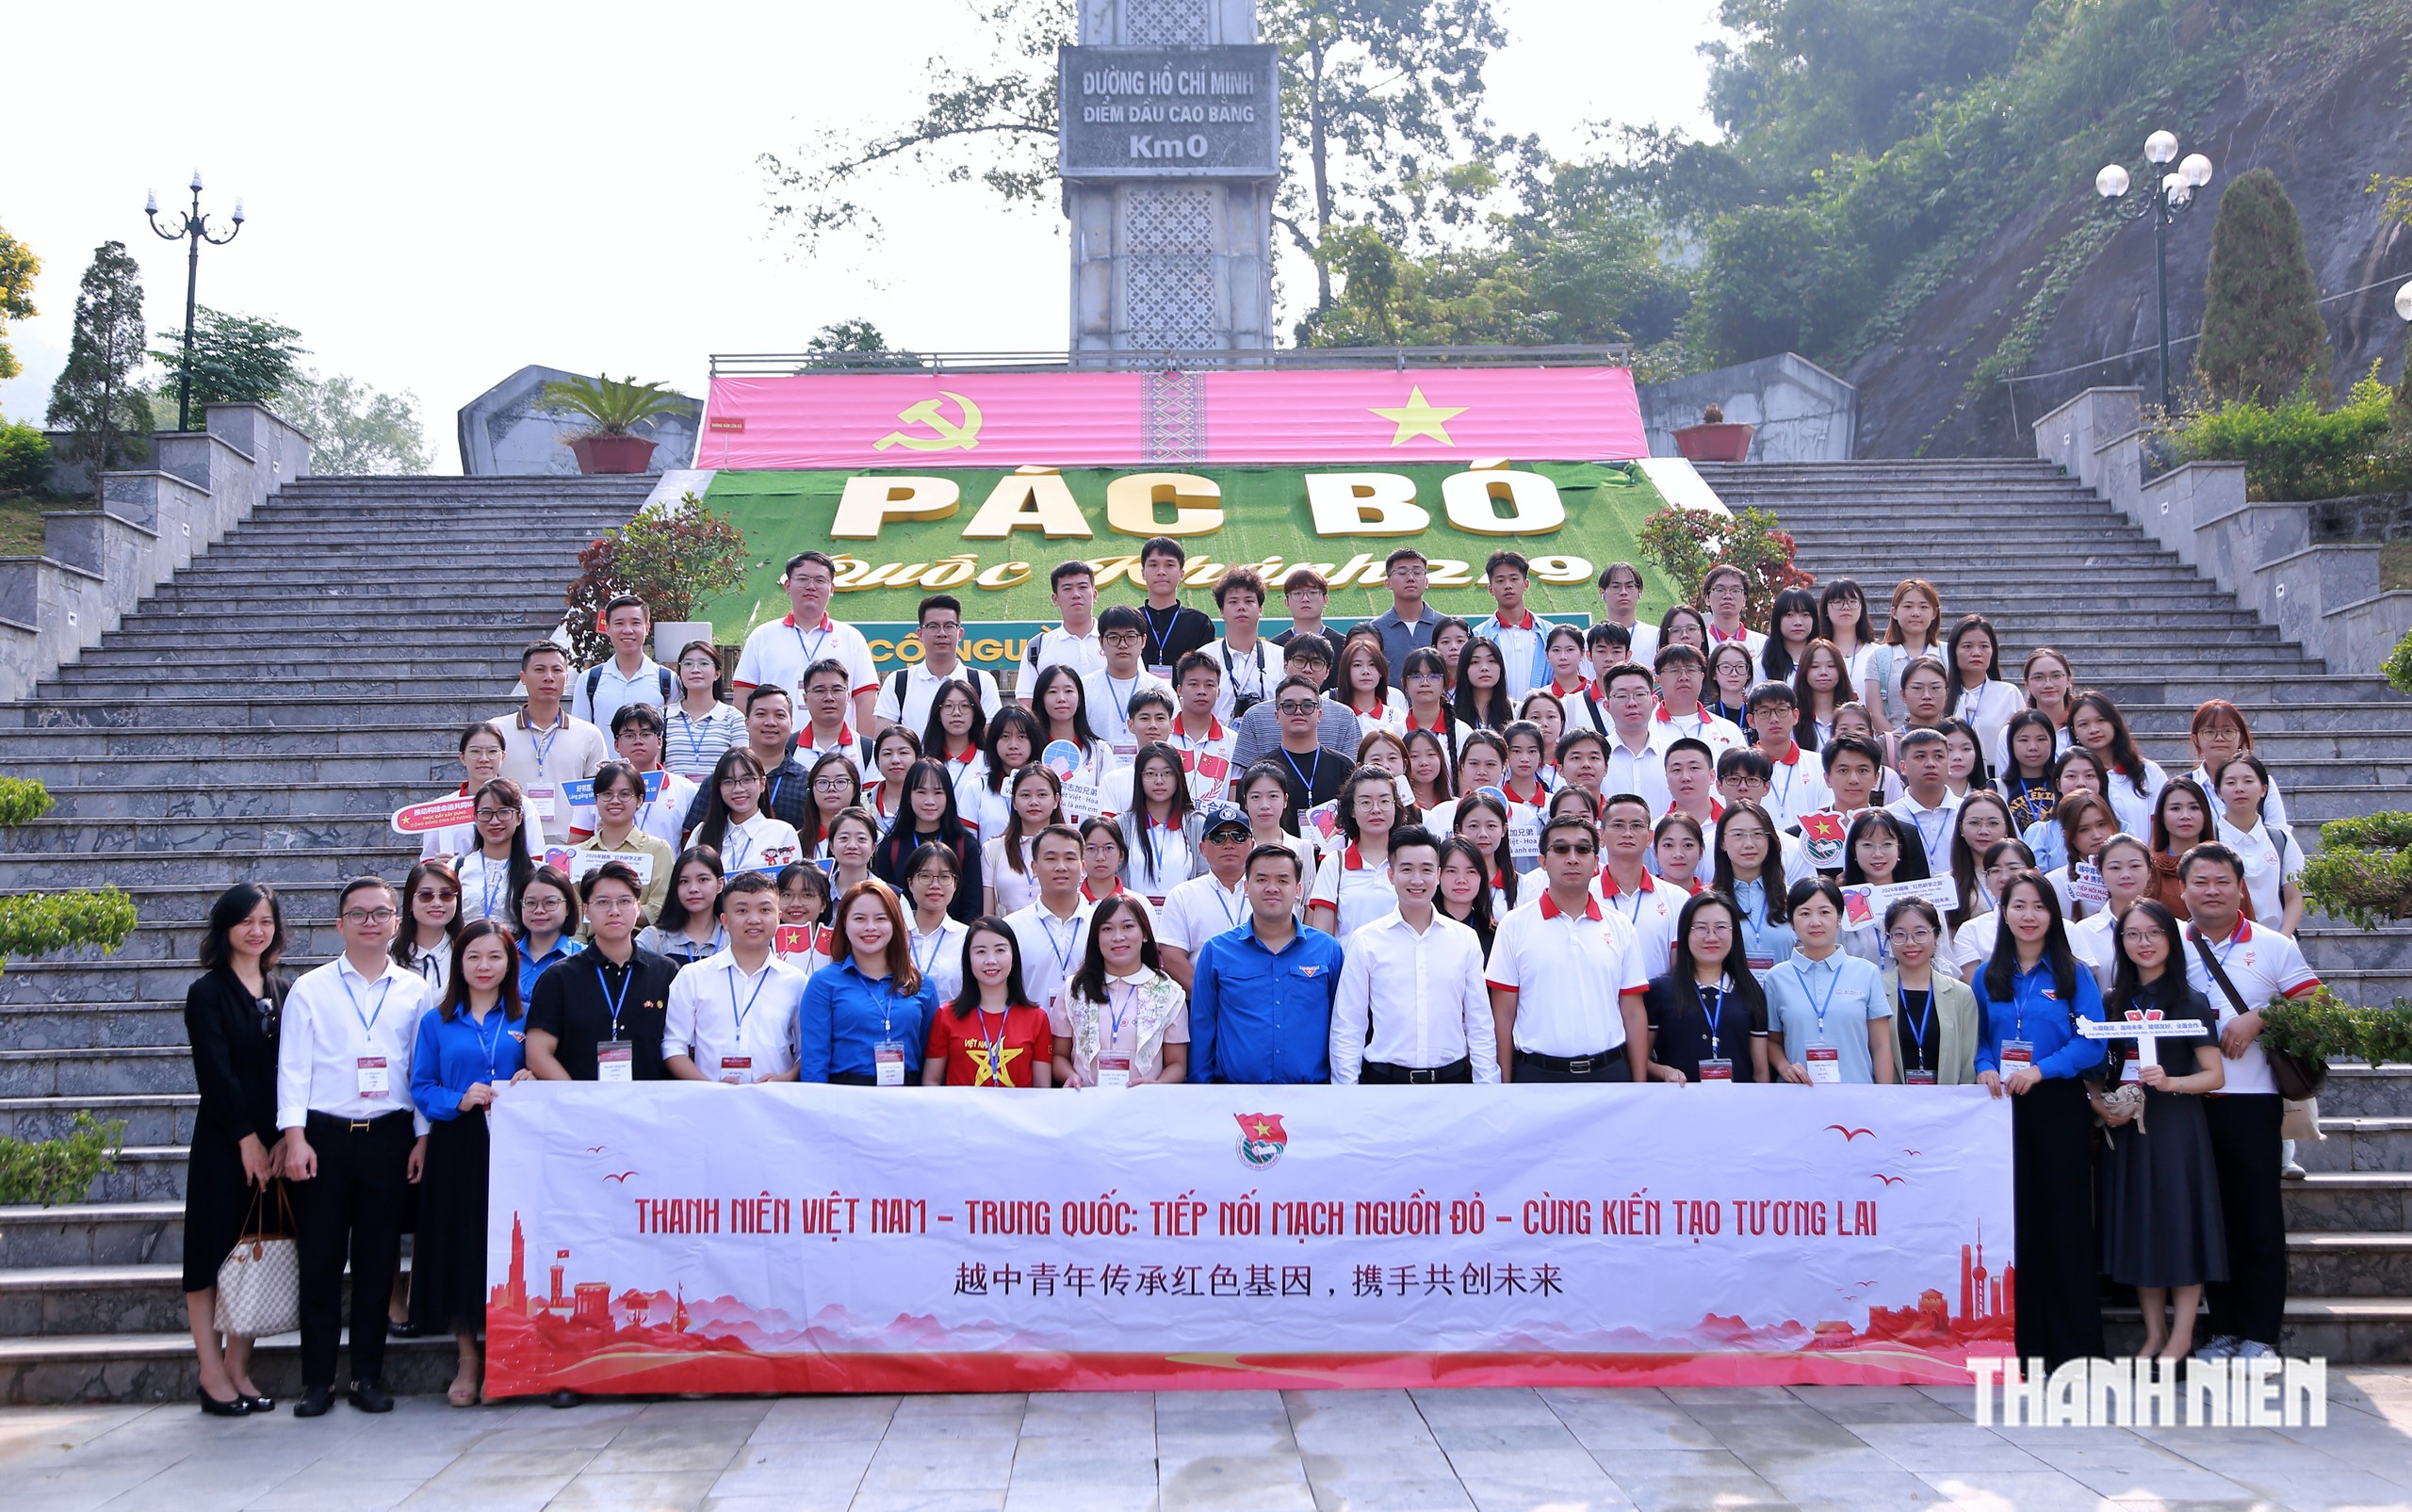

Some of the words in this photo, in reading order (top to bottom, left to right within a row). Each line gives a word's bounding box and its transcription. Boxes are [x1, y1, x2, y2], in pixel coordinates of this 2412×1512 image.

[1084, 64, 1144, 95] ĐƯỜNG
[1149, 61, 1172, 95] HỒ
[1178, 65, 1205, 95] CHÍ
[1211, 71, 1254, 95] MINH
[1084, 95, 1124, 122] ĐIỂM
[1130, 98, 1164, 122] ĐẦU
[1169, 106, 1204, 122] CAO
[1209, 96, 1254, 122] BẰNG
[831, 464, 1224, 540] PÁC
[1305, 458, 1566, 538] BÓ
[1068, 792, 1082, 801] Việt
[1085, 796, 1099, 805] Hoa
[978, 1040, 992, 1049] NA
[634, 1198, 719, 1234] THANH
[731, 1190, 790, 1234] NIÊN
[802, 1190, 860, 1242] VIỆT
[872, 1198, 926, 1234] NAM
[965, 1200, 1051, 1235] TRUNG
[1062, 1189, 1138, 1237] QUỐC:
[1149, 1189, 1208, 1237] TIẾP
[1219, 1189, 1261, 1236] NỐI
[1273, 1200, 1344, 1244] MẠCH
[1355, 1189, 1441, 1236] NGUỒN
[1449, 1192, 1485, 1236] ĐỎ
[1523, 1191, 1591, 1236] CÙNG
[1603, 1187, 1661, 1236] KIẾN
[1671, 1198, 1720, 1244] TẠO
[1732, 1198, 1826, 1236] TƯƠNG
[1837, 1199, 1878, 1236] LAI
[953, 1261, 1563, 1297] 越中青年传承红色基因，携手共创未来
